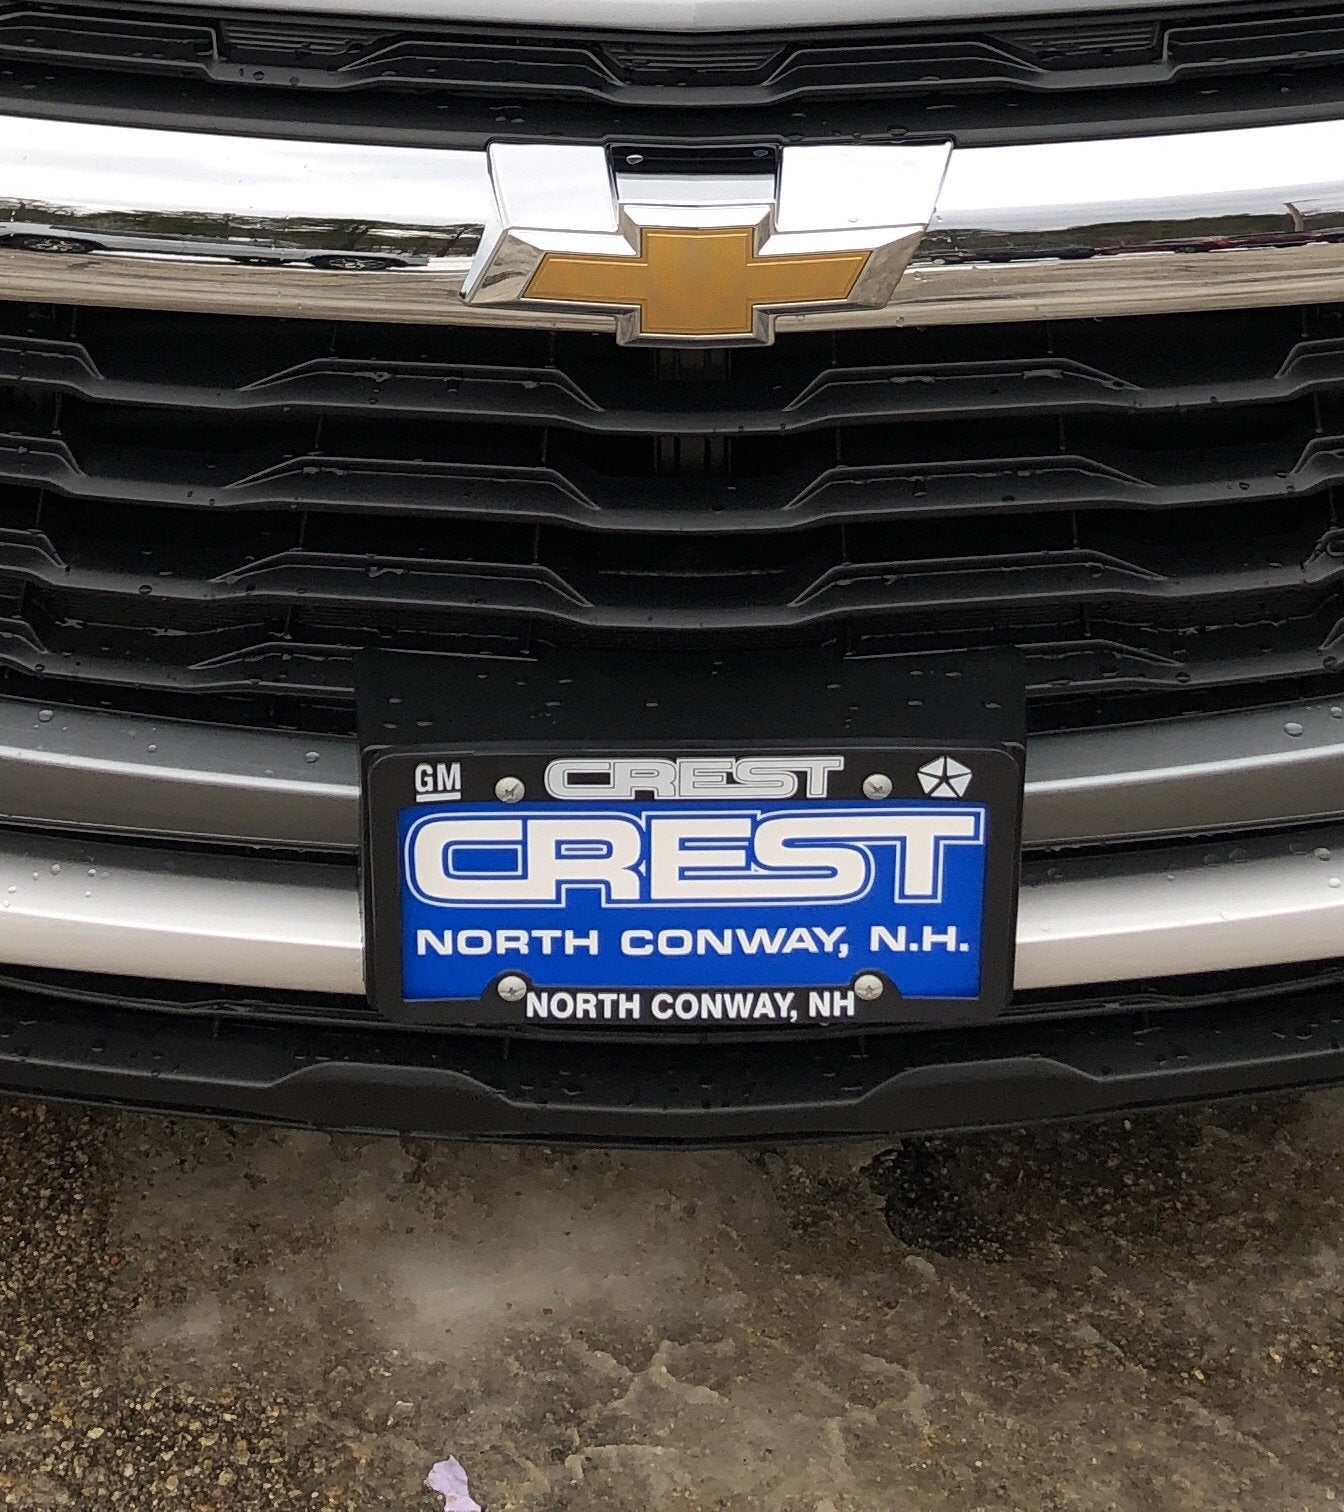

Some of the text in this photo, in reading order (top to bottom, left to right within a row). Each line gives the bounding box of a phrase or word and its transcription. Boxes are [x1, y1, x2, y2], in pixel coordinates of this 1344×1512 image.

[414, 762, 462, 793] GM
[544, 756, 844, 800] CREST
[404, 807, 985, 908] CREST
[416, 925, 970, 959] NORTH CONWAY, N.H.
[526, 990, 855, 1023] NORTH CONWAY, NH
